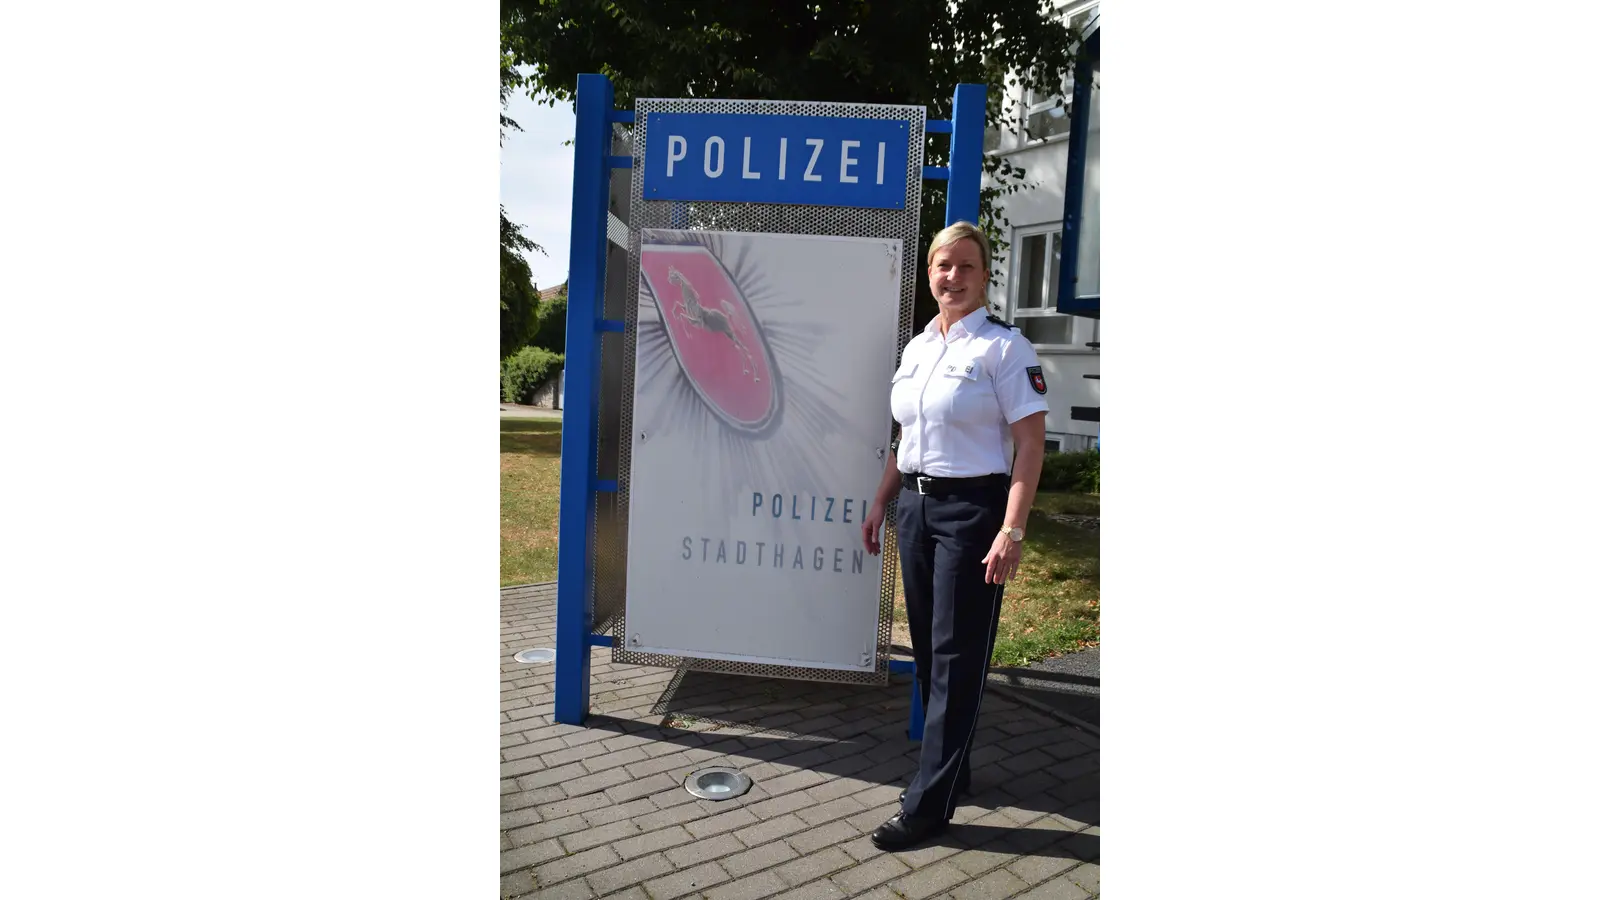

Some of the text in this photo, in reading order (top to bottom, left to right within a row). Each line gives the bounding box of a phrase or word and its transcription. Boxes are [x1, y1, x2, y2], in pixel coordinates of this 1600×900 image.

[666, 135, 886, 185] POLIZEI
[752, 492, 867, 523] POLIZEI
[682, 536, 864, 574] STADTHAGEN
